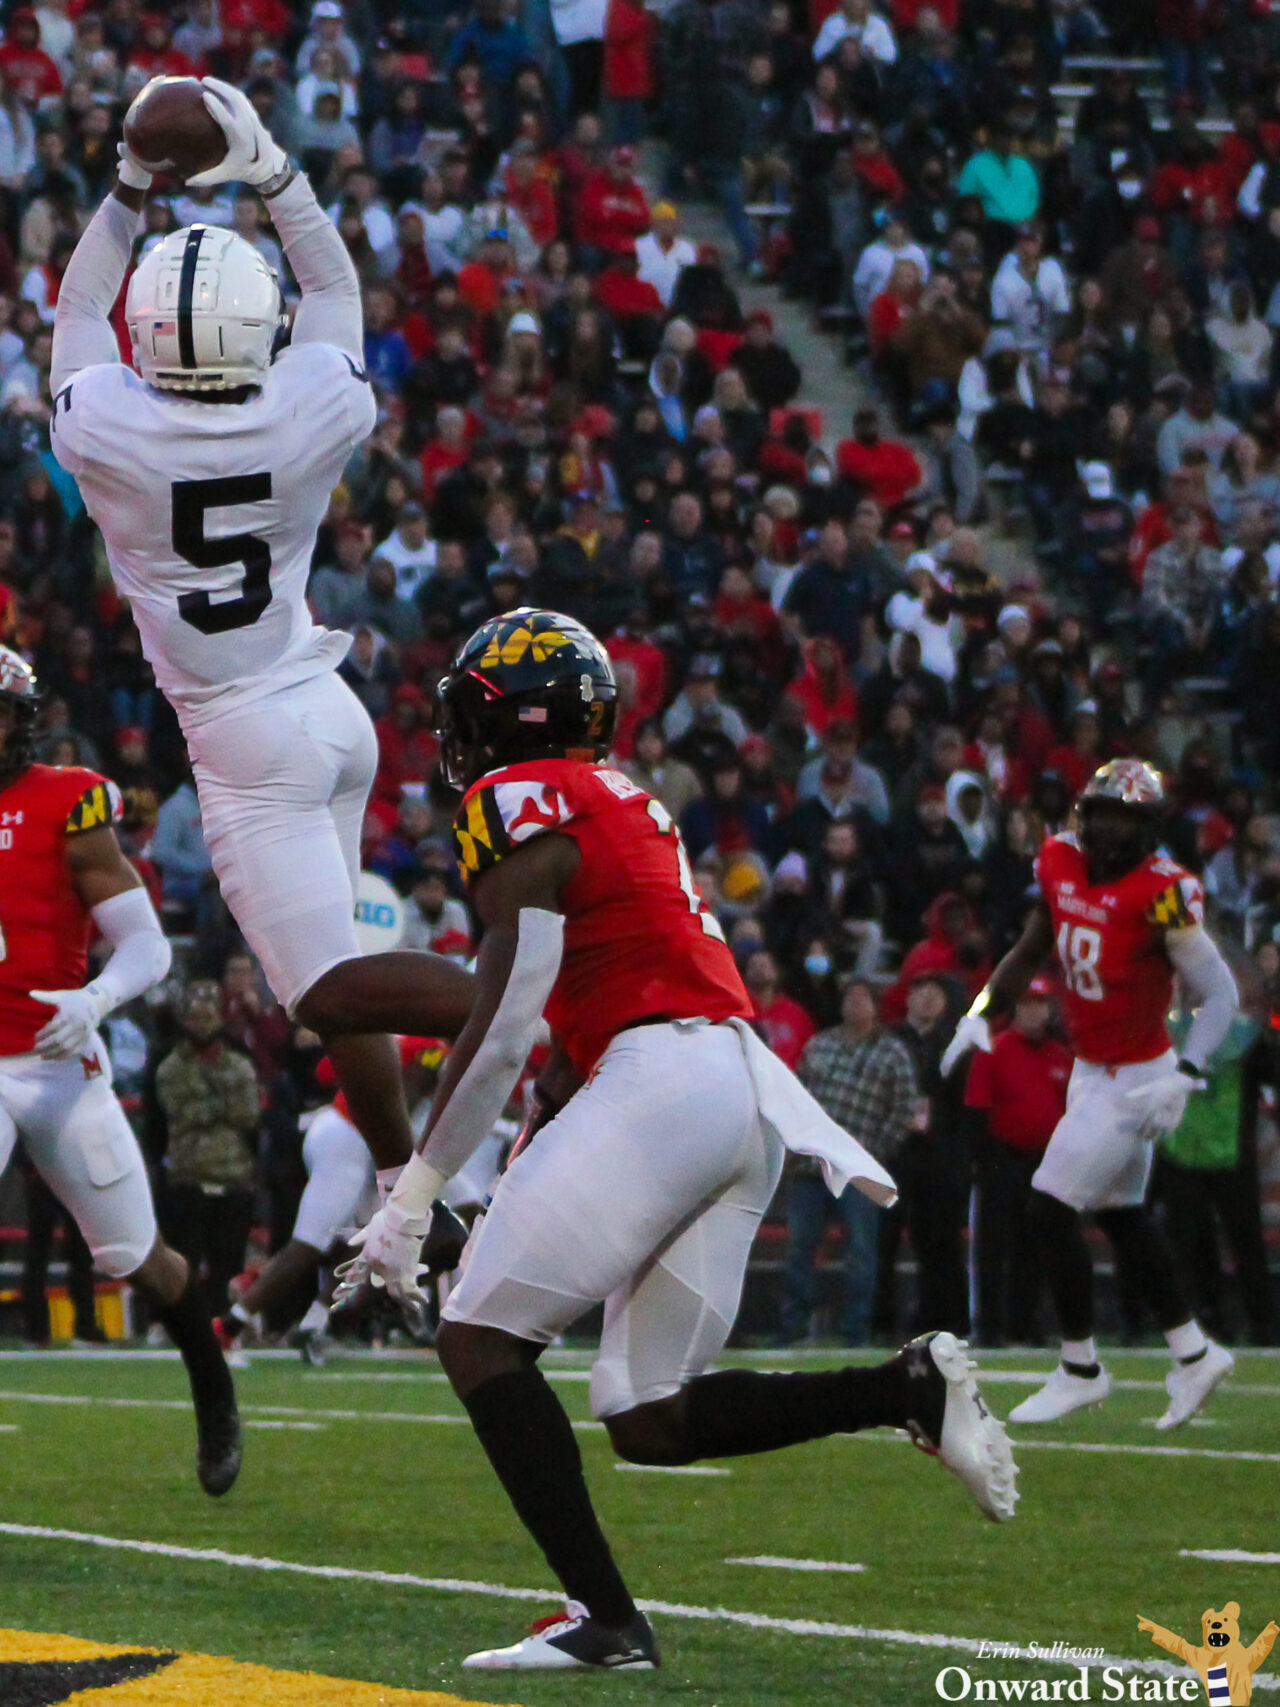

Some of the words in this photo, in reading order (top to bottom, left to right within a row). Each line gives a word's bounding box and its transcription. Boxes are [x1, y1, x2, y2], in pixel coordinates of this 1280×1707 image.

[171, 472, 273, 635] 5
[587, 701, 605, 736] 2
[1057, 921, 1105, 1001] 18
